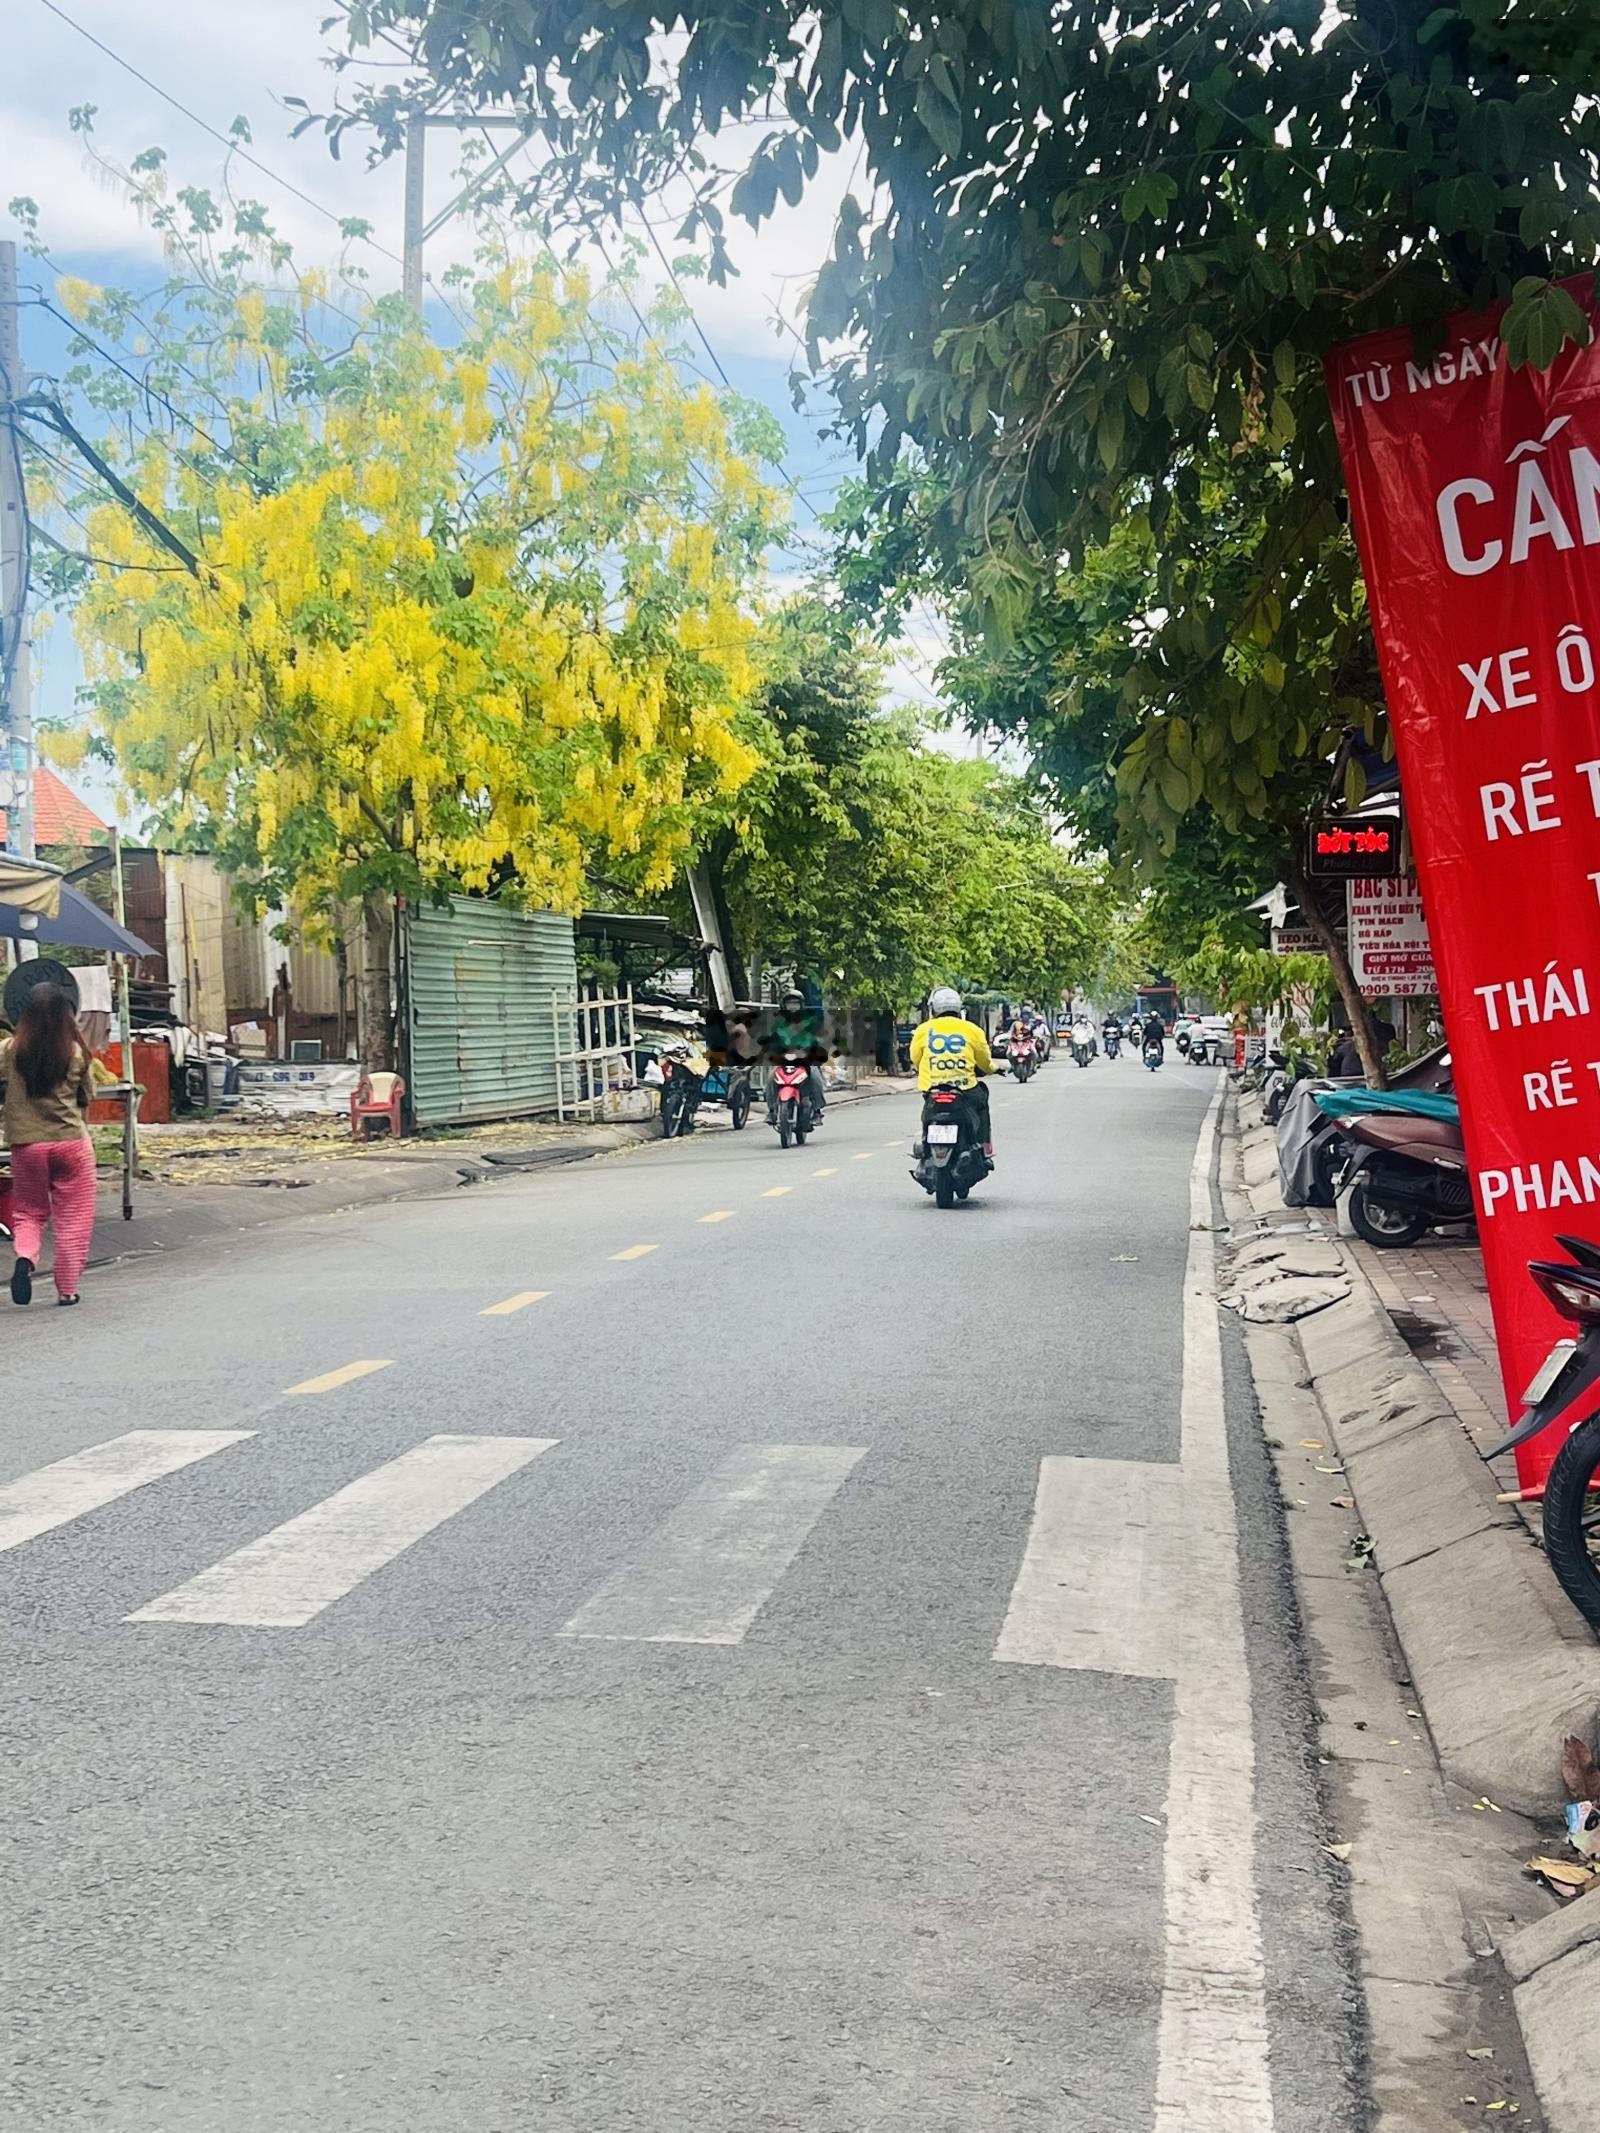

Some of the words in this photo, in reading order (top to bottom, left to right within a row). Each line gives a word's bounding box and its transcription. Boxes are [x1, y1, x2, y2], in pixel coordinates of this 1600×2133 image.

[1345, 360, 1391, 407] TỪ
[1405, 336, 1499, 394] NGÀY
[1457, 647, 1537, 720] XE
[1556, 623, 1595, 694] Ô
[1479, 757, 1562, 842] RẼ
[1359, 984, 1390, 995] 0909
[1394, 983, 1417, 994] 587
[1474, 960, 1591, 1032] THÁI
[927, 1027, 966, 1055] be
[1522, 1058, 1578, 1112] RẼ
